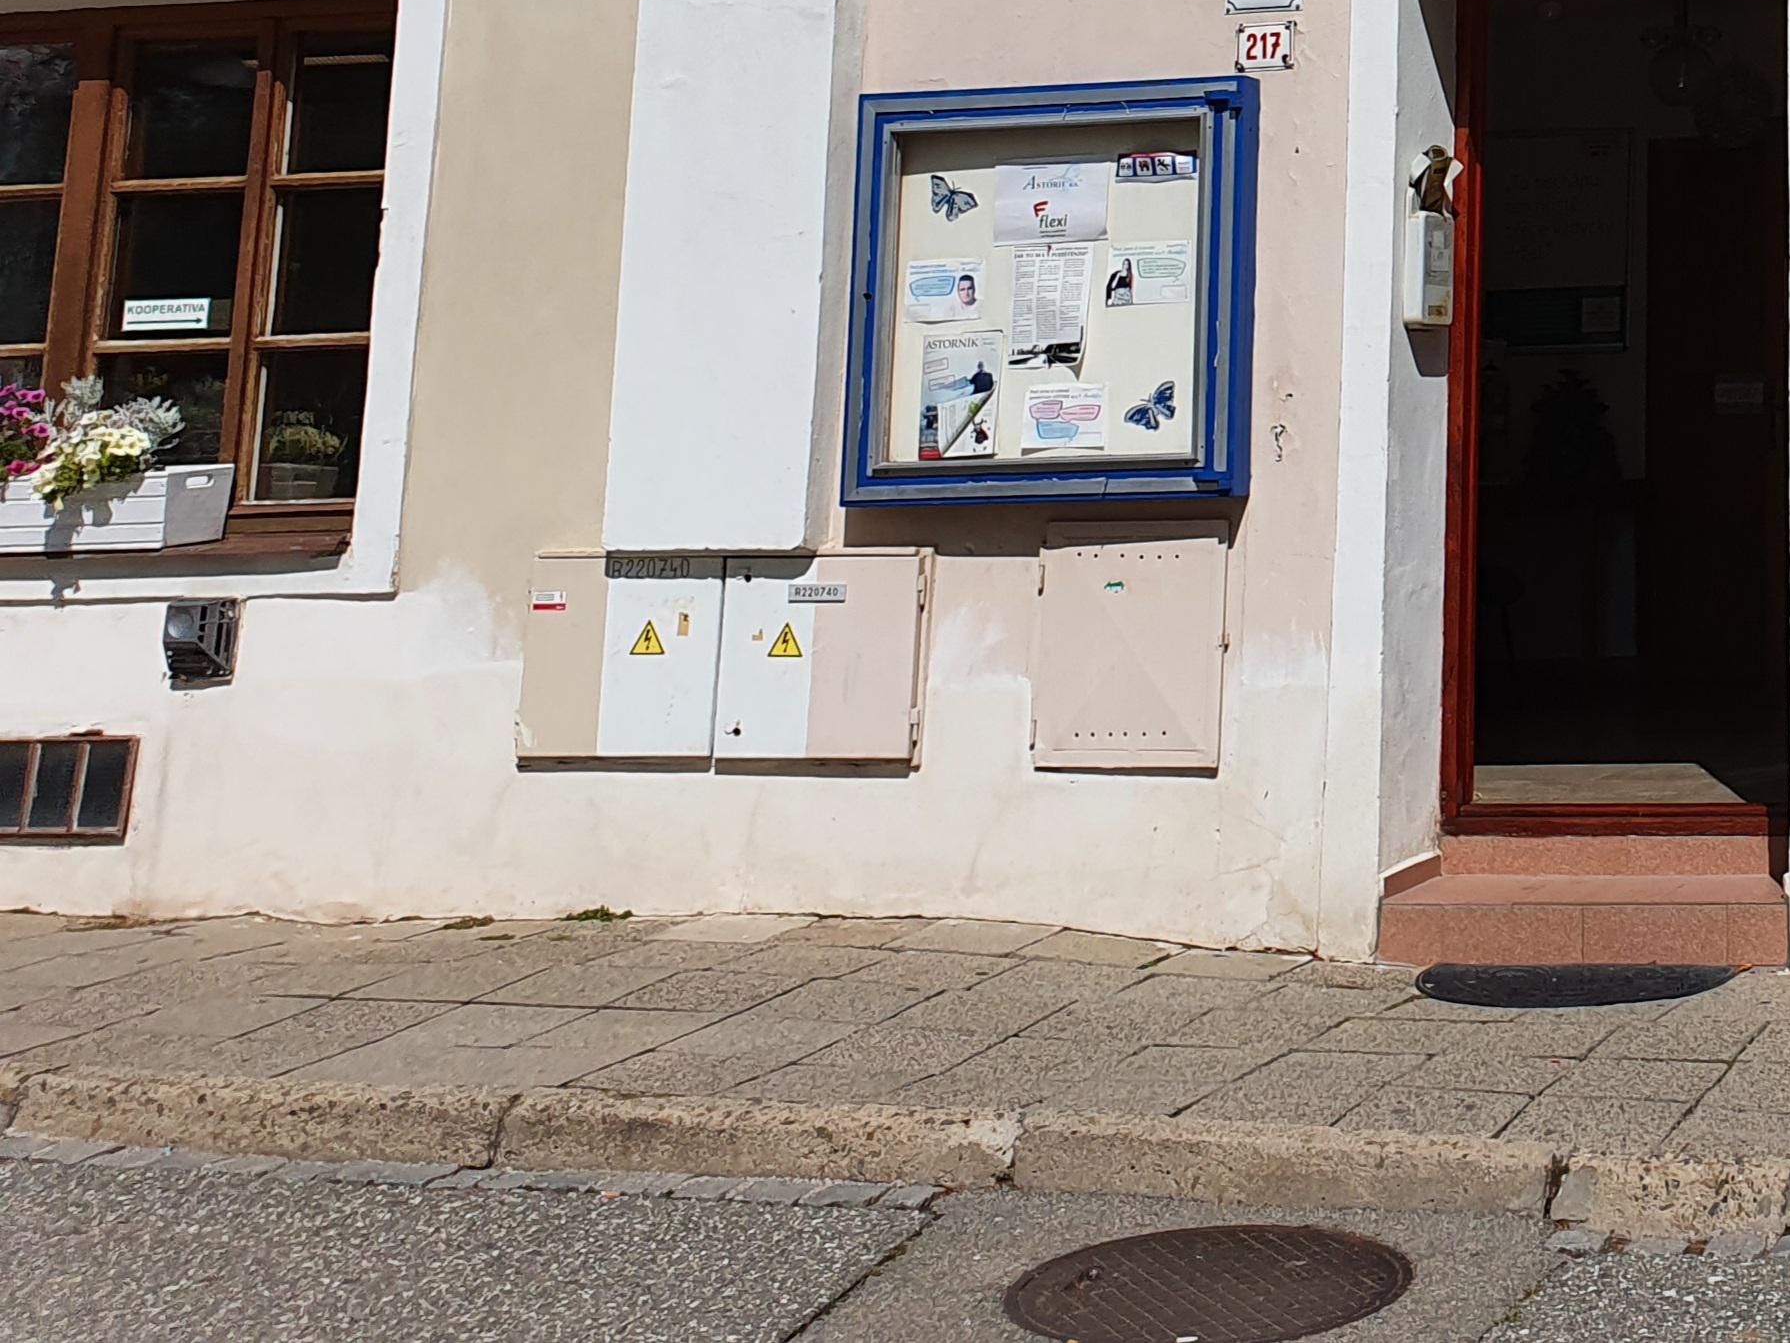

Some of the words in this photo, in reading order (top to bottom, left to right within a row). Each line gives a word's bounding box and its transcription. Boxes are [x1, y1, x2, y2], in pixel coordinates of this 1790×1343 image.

[1245, 31, 1282, 60] 217
[1039, 213, 1068, 229] flexi
[126, 303, 206, 316] KOOPERATIVA
[611, 557, 691, 578] R220740
[794, 586, 840, 597] R220740
